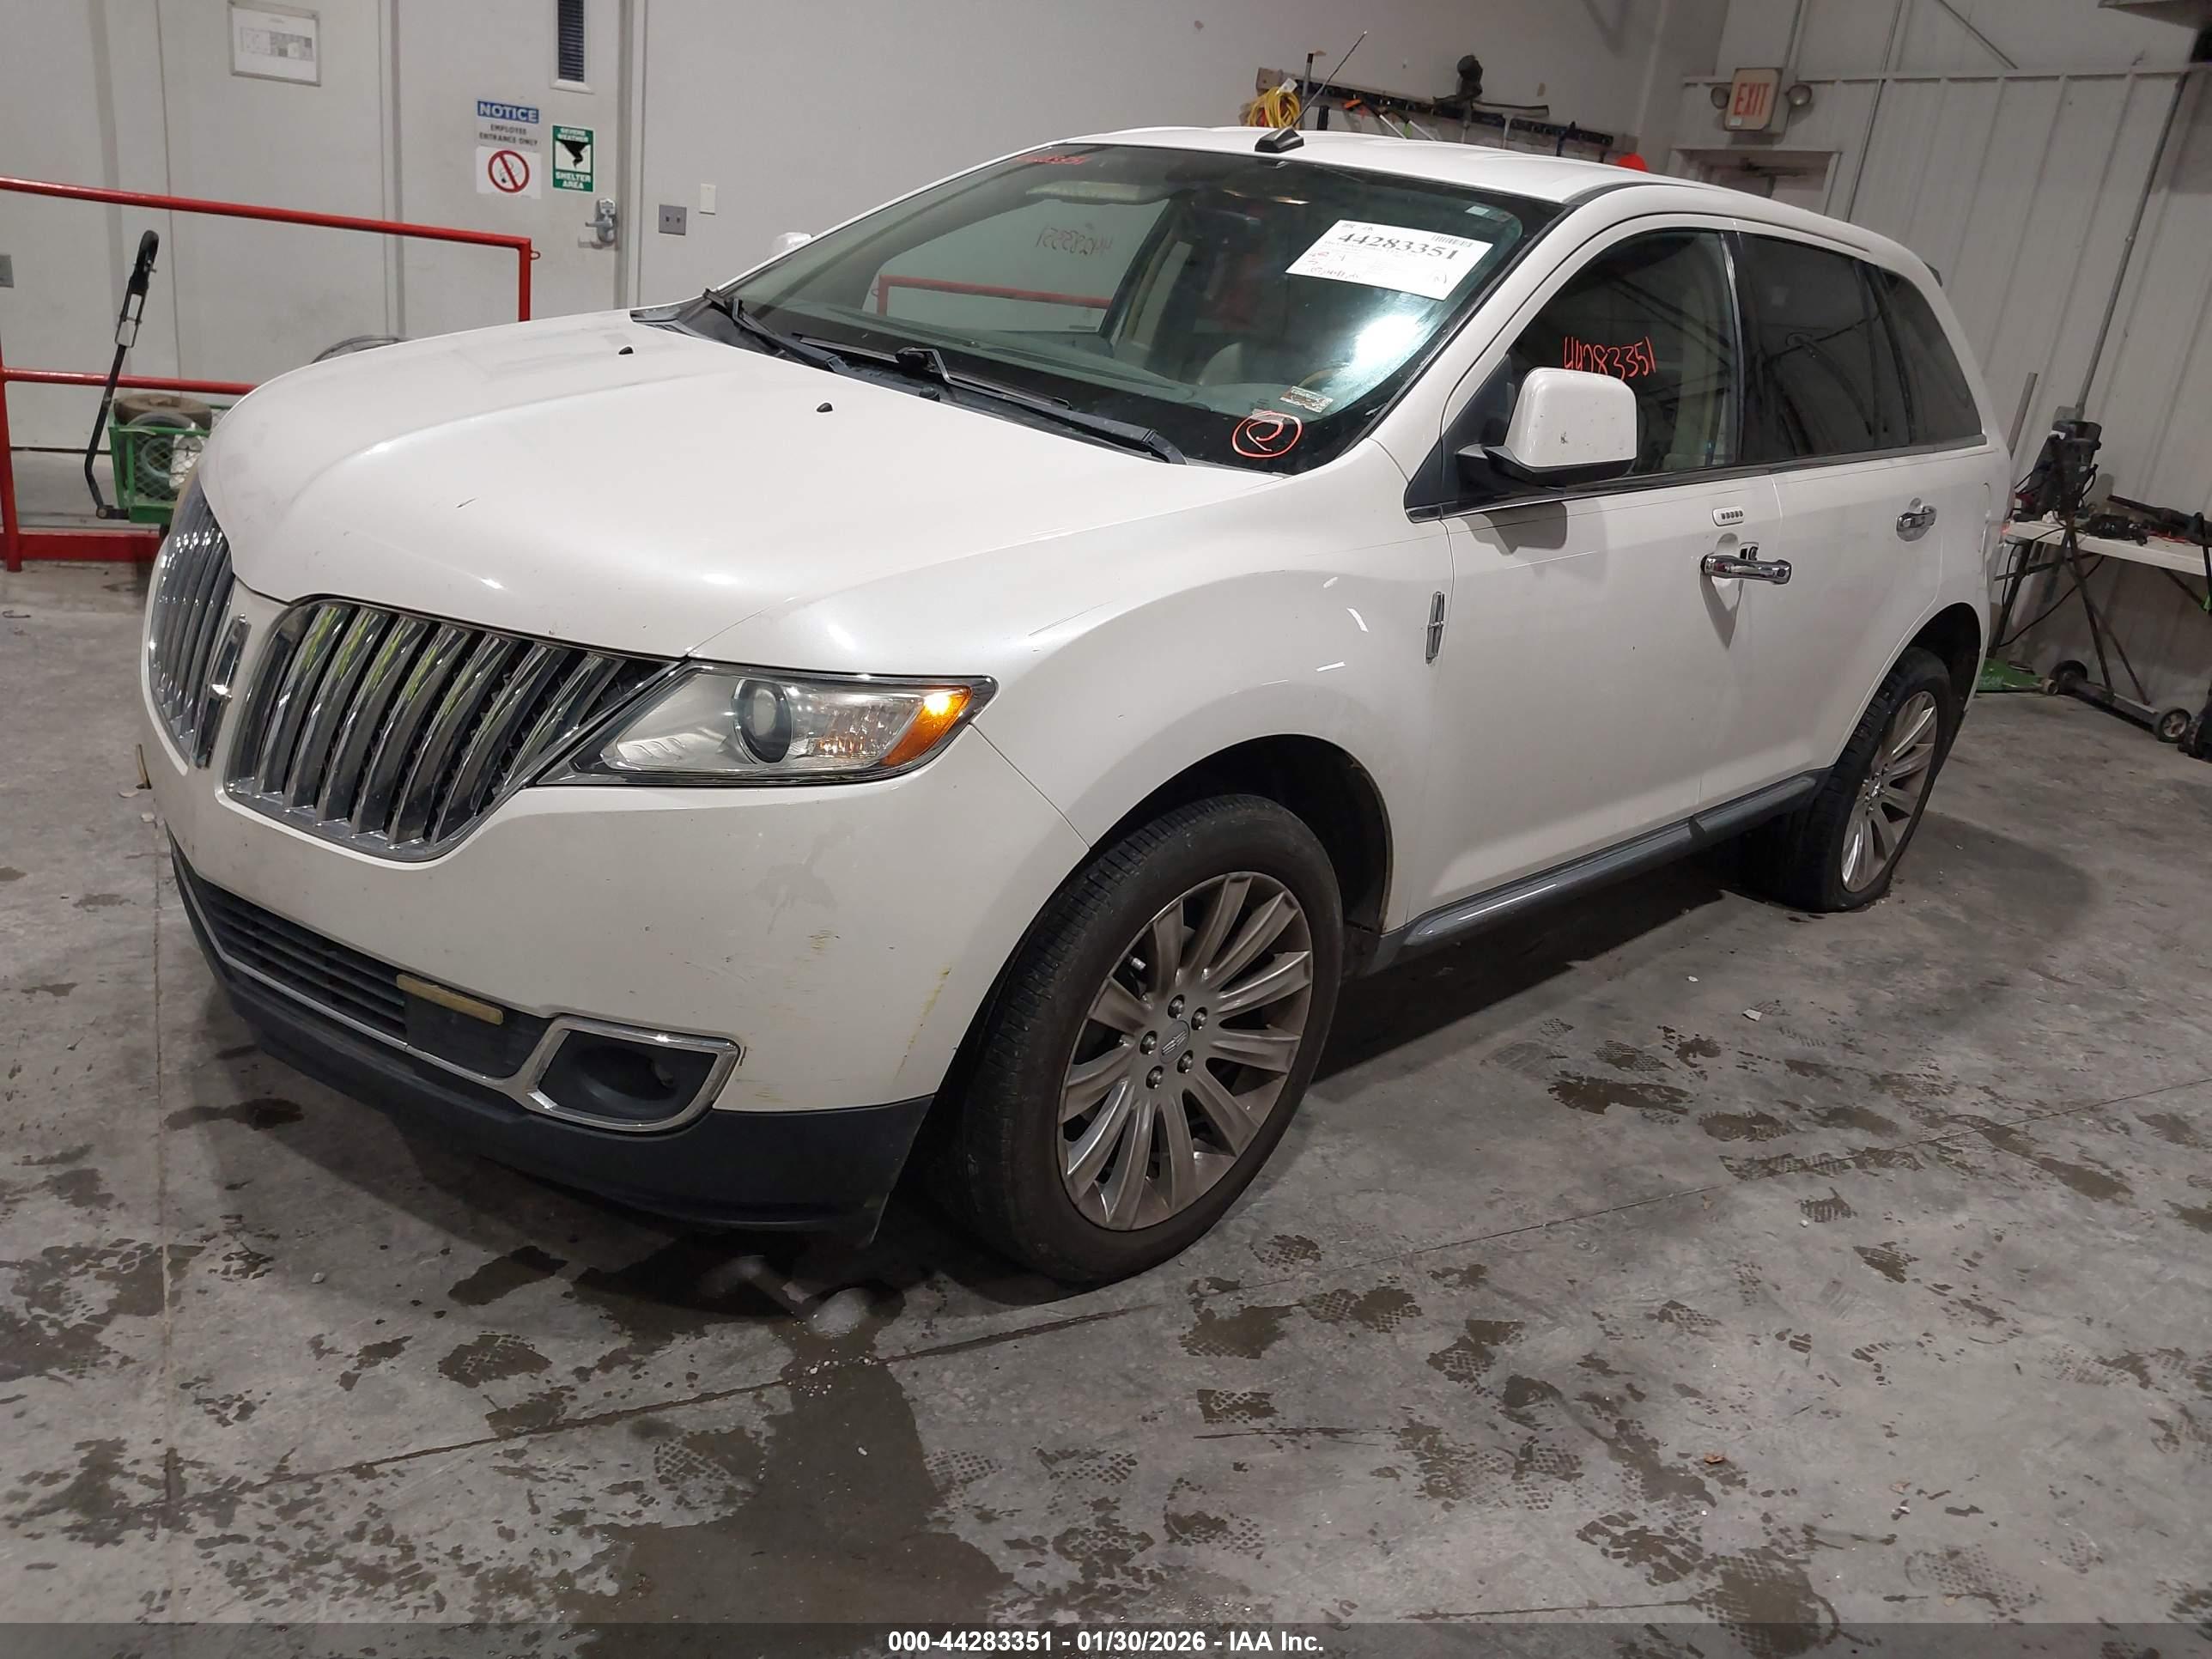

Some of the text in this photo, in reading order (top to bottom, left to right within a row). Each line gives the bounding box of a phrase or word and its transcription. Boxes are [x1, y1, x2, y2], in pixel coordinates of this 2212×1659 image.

[1733, 82, 1770, 116] EXIT
[480, 102, 537, 122] NOTICE
[490, 124, 526, 135] EMPLOYEE
[560, 128, 586, 137] SEVERE
[479, 131, 516, 143] ENTRANCE
[556, 171, 591, 183] SHELTER
[562, 180, 584, 189] AREA
[1338, 233, 1459, 260] 44283351
